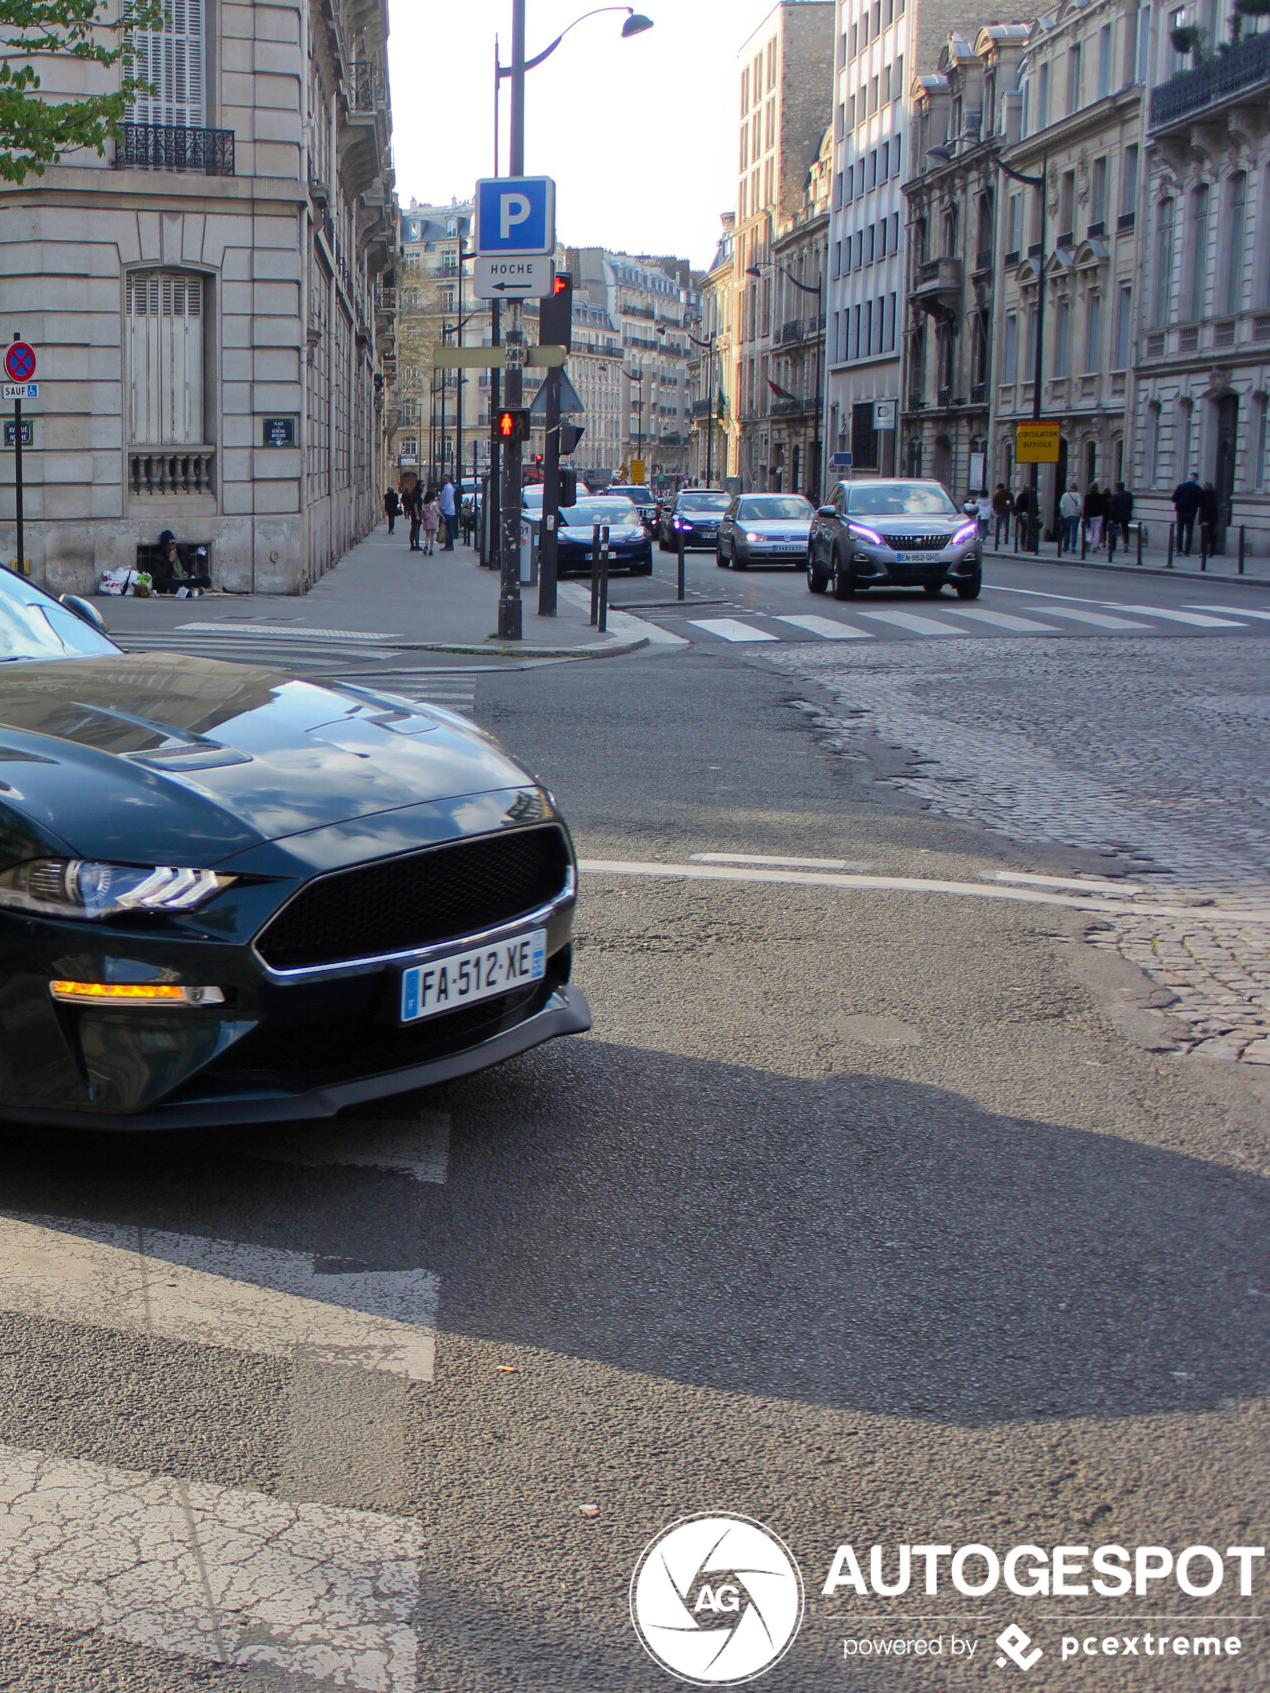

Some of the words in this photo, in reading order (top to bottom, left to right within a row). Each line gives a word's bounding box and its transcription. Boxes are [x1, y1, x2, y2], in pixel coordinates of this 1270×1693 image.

[499, 192, 531, 239] P
[490, 263, 534, 275] HOCHE
[5, 386, 26, 396] SAUF
[1023, 441, 1052, 449] DIFFICILE
[421, 940, 530, 1008] FA-512-XE
